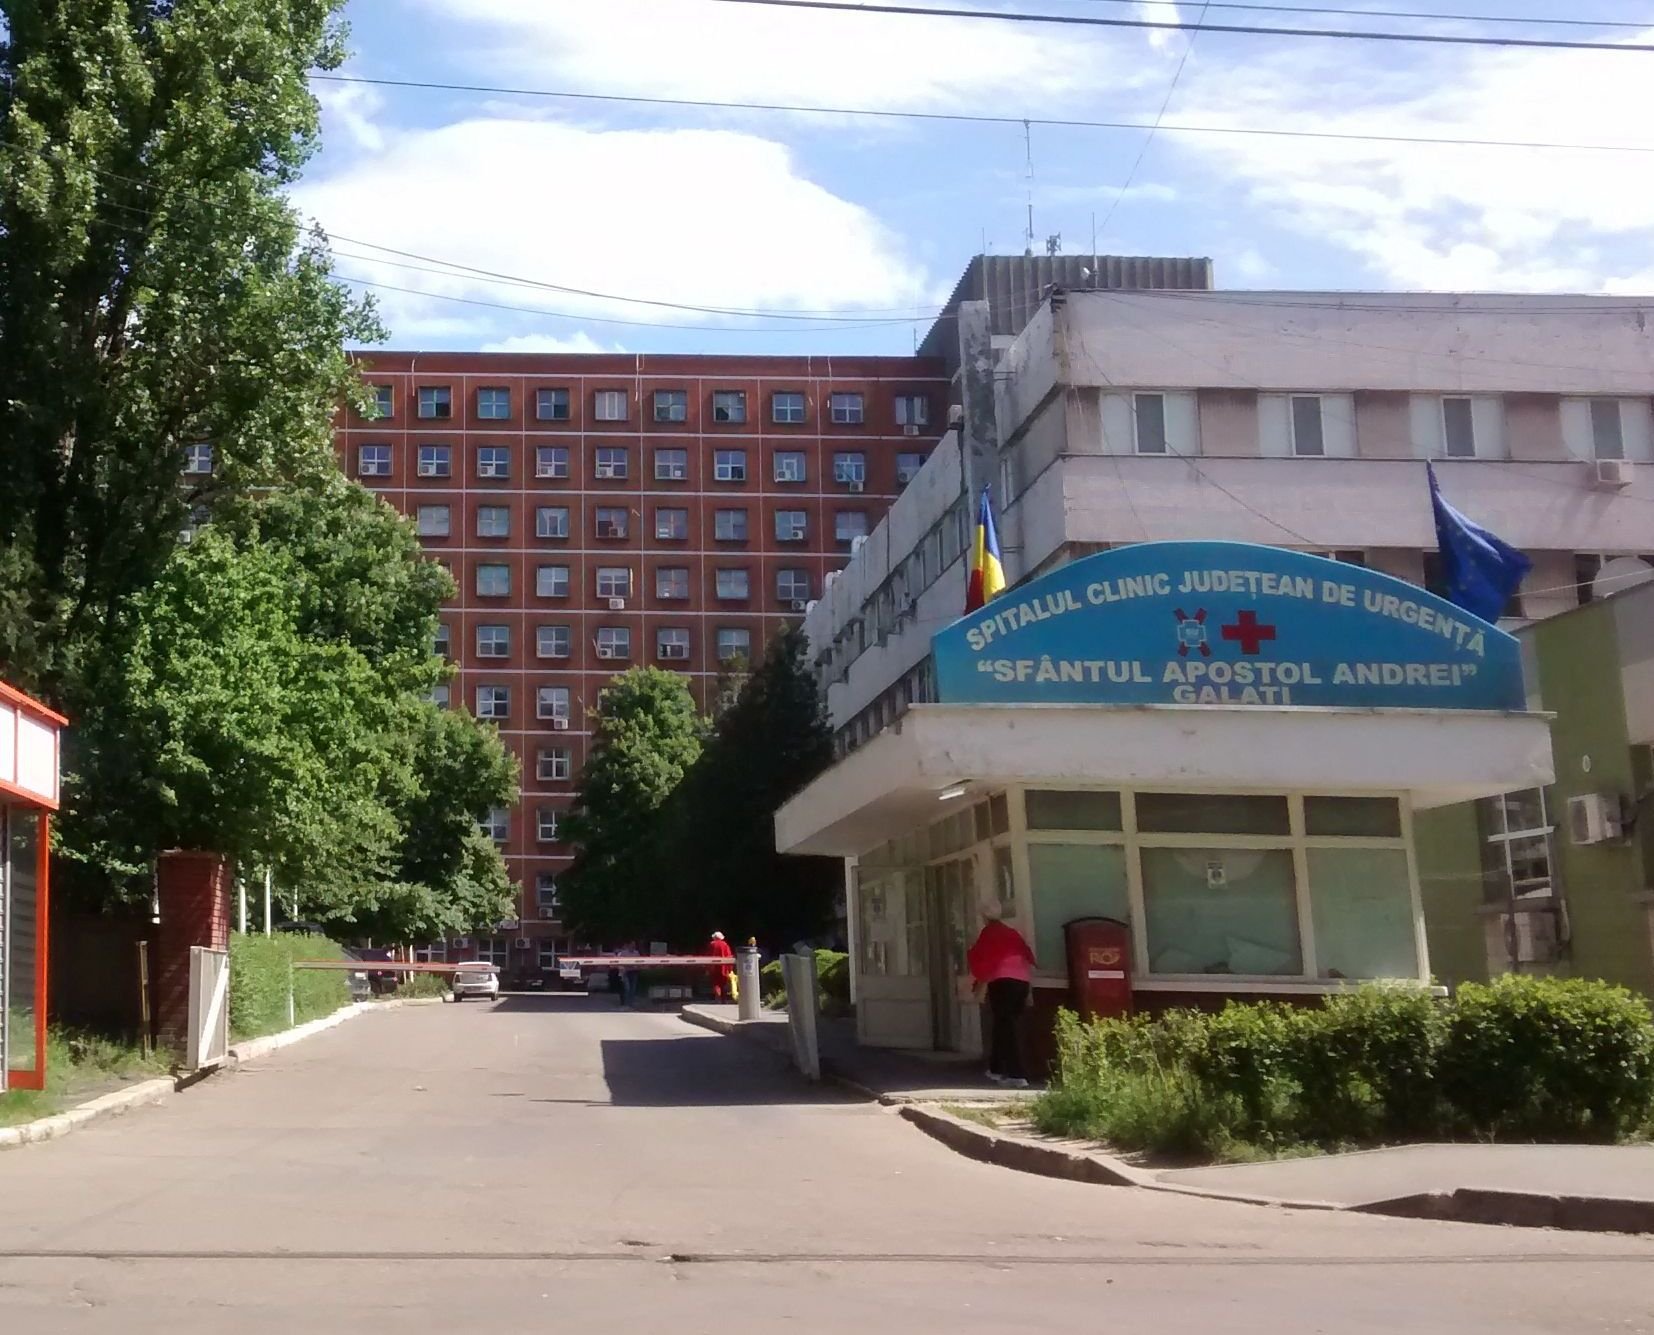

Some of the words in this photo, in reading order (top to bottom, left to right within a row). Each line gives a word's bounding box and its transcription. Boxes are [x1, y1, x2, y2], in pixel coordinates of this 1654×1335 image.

[966, 589, 1082, 651] SPITALUL
[1086, 572, 1171, 605] CLINIC
[1322, 580, 1356, 607] DE
[1162, 661, 1322, 684] APOSTOL
[1173, 685, 1291, 704] GALATI
